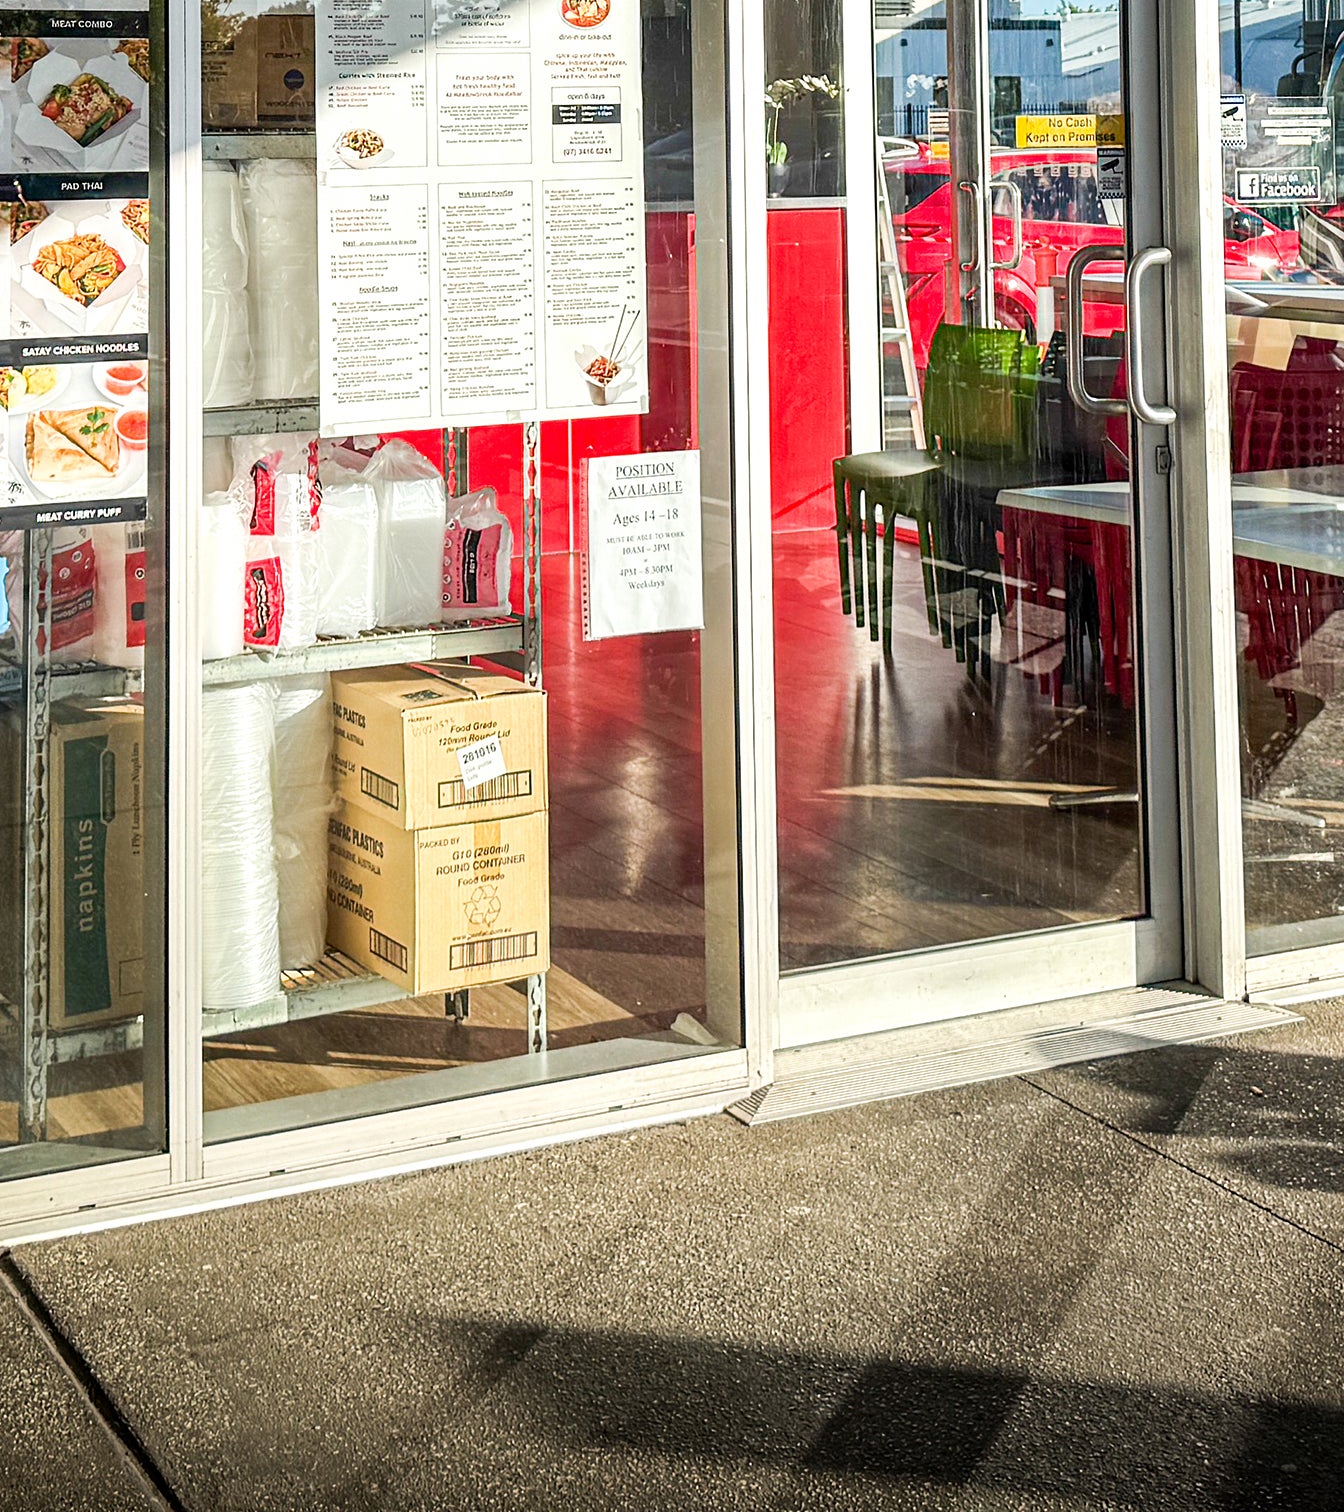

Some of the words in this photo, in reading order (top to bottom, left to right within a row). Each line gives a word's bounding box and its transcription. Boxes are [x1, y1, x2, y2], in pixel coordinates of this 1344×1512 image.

[51, 20, 76, 28] MEAT
[78, 20, 113, 29] COMBO
[1048, 117, 1063, 128] No
[1065, 117, 1092, 128] Cash
[1026, 132, 1049, 143] Kept
[1052, 134, 1066, 142] on
[1068, 132, 1116, 142] Premises
[61, 182, 79, 190] PAD
[82, 181, 103, 190] THAI
[1261, 173, 1277, 183] Find
[1278, 174, 1287, 182] us
[1288, 174, 1298, 182] on
[1261, 182, 1316, 197] Facebook
[22, 347, 51, 357] SATAY
[53, 345, 94, 355] CHICKEN
[96, 342, 139, 353] NOODLES
[615, 462, 675, 478] POSITION
[608, 480, 683, 498] AVAILABLE
[37, 512, 62, 523] MEAT
[64, 509, 96, 521] CURRY
[98, 507, 122, 518] PUFF
[613, 513, 640, 527] Ages
[644, 509, 655, 522] 14
[665, 531, 685, 539] WORK
[622, 545, 645, 556] 10AM
[653, 543, 670, 553] 3PM
[619, 567, 637, 577] 4PM
[628, 579, 665, 590] Weekdays
[343, 707, 366, 729] PLASTICS
[450, 723, 471, 734] Food
[473, 720, 498, 731] Grade
[438, 735, 467, 747] 120mm
[498, 729, 511, 739] Lid
[462, 742, 497, 764] 281016
[352, 828, 384, 859] PLASTICS
[420, 839, 449, 849] PACKED
[450, 837, 460, 845] BY
[452, 849, 472, 861] G10
[474, 844, 510, 859] (280ml)
[436, 863, 470, 876] ROUND
[472, 854, 526, 870] CONTAINER
[74, 818, 97, 932] napkins
[457, 877, 479, 887] Food
[481, 872, 505, 882] Grade
[337, 892, 374, 924] CONTAINER
